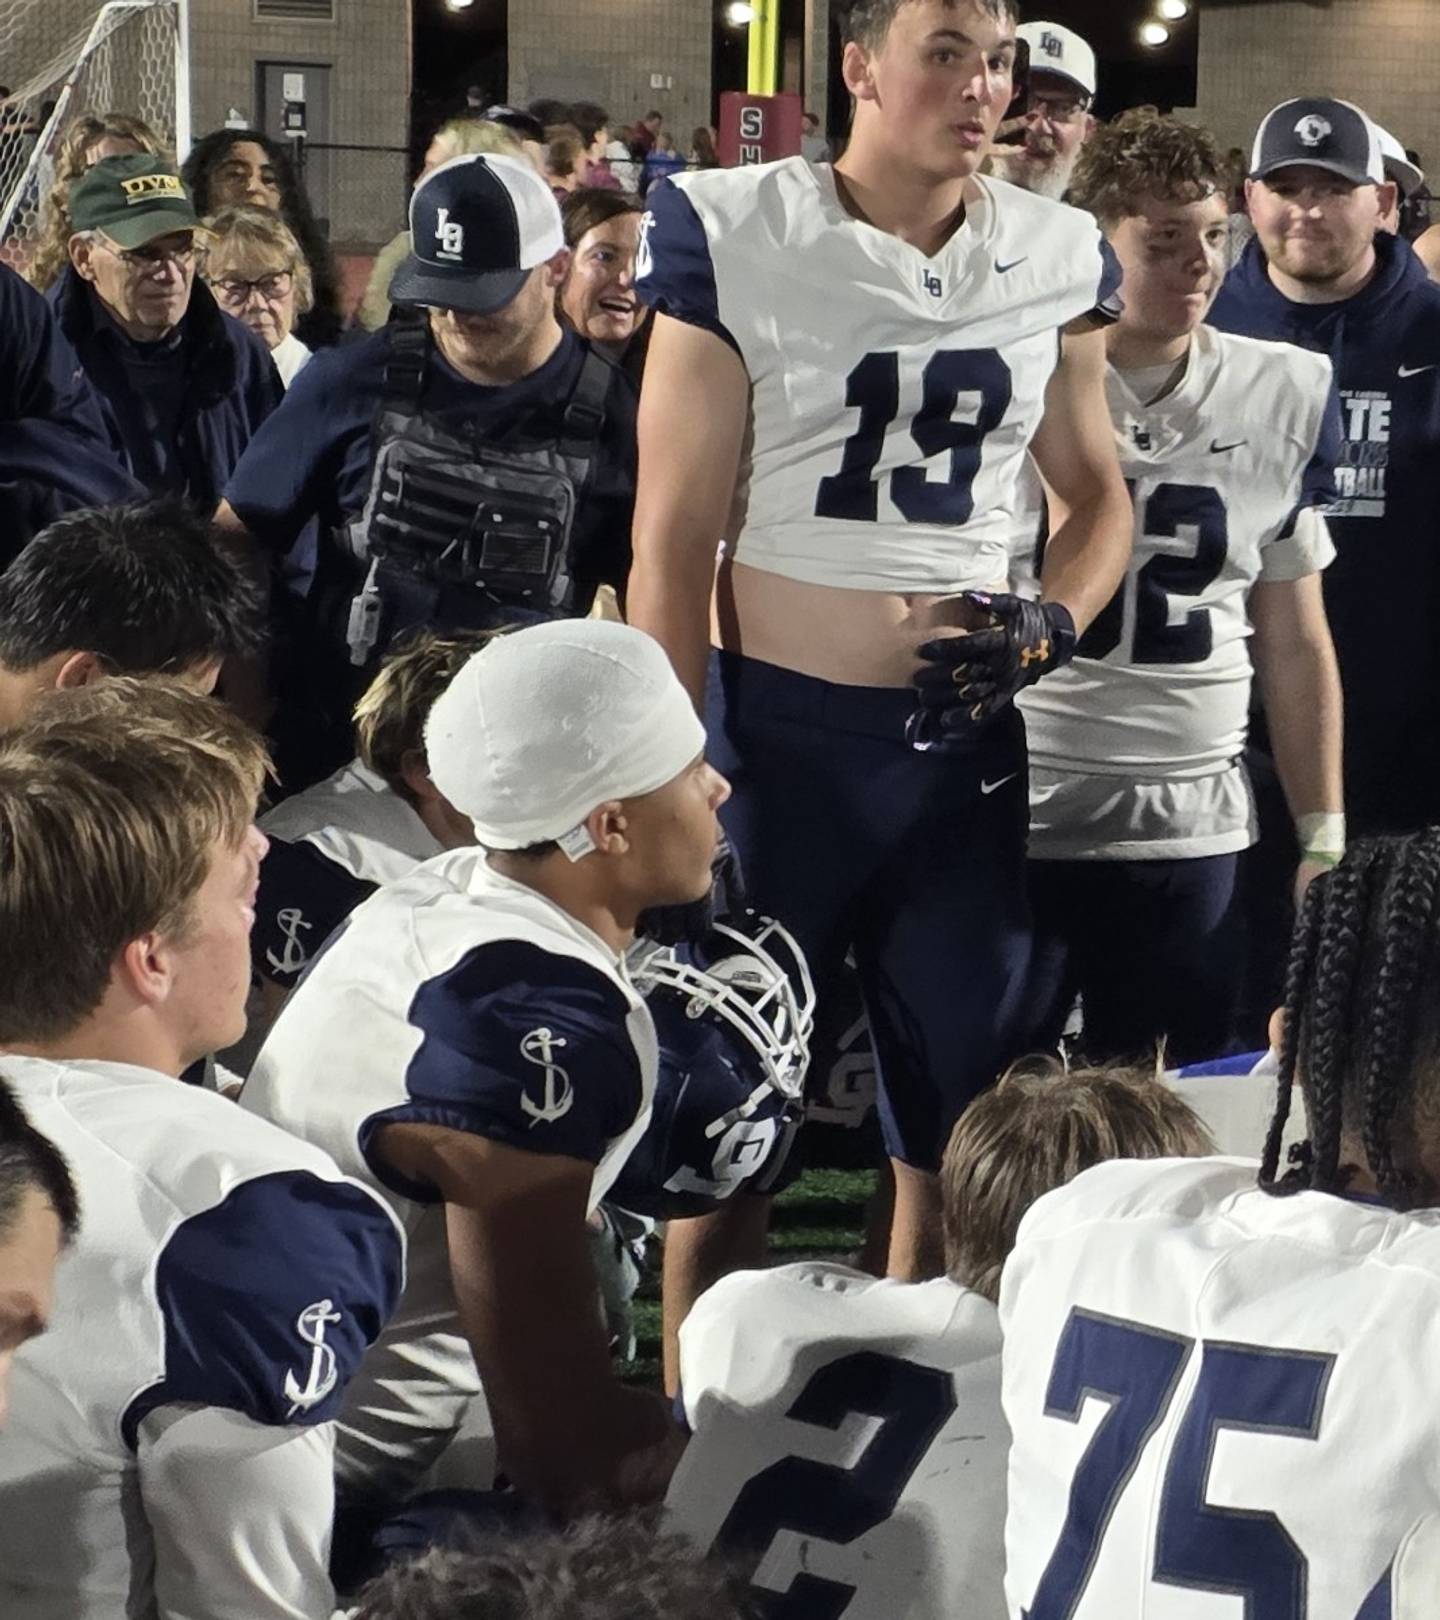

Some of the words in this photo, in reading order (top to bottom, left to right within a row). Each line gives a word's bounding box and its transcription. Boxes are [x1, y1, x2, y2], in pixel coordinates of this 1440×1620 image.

[814, 347, 1013, 525] 19
[1333, 467, 1386, 498] TBALL
[1021, 1305, 1339, 1620] 75
